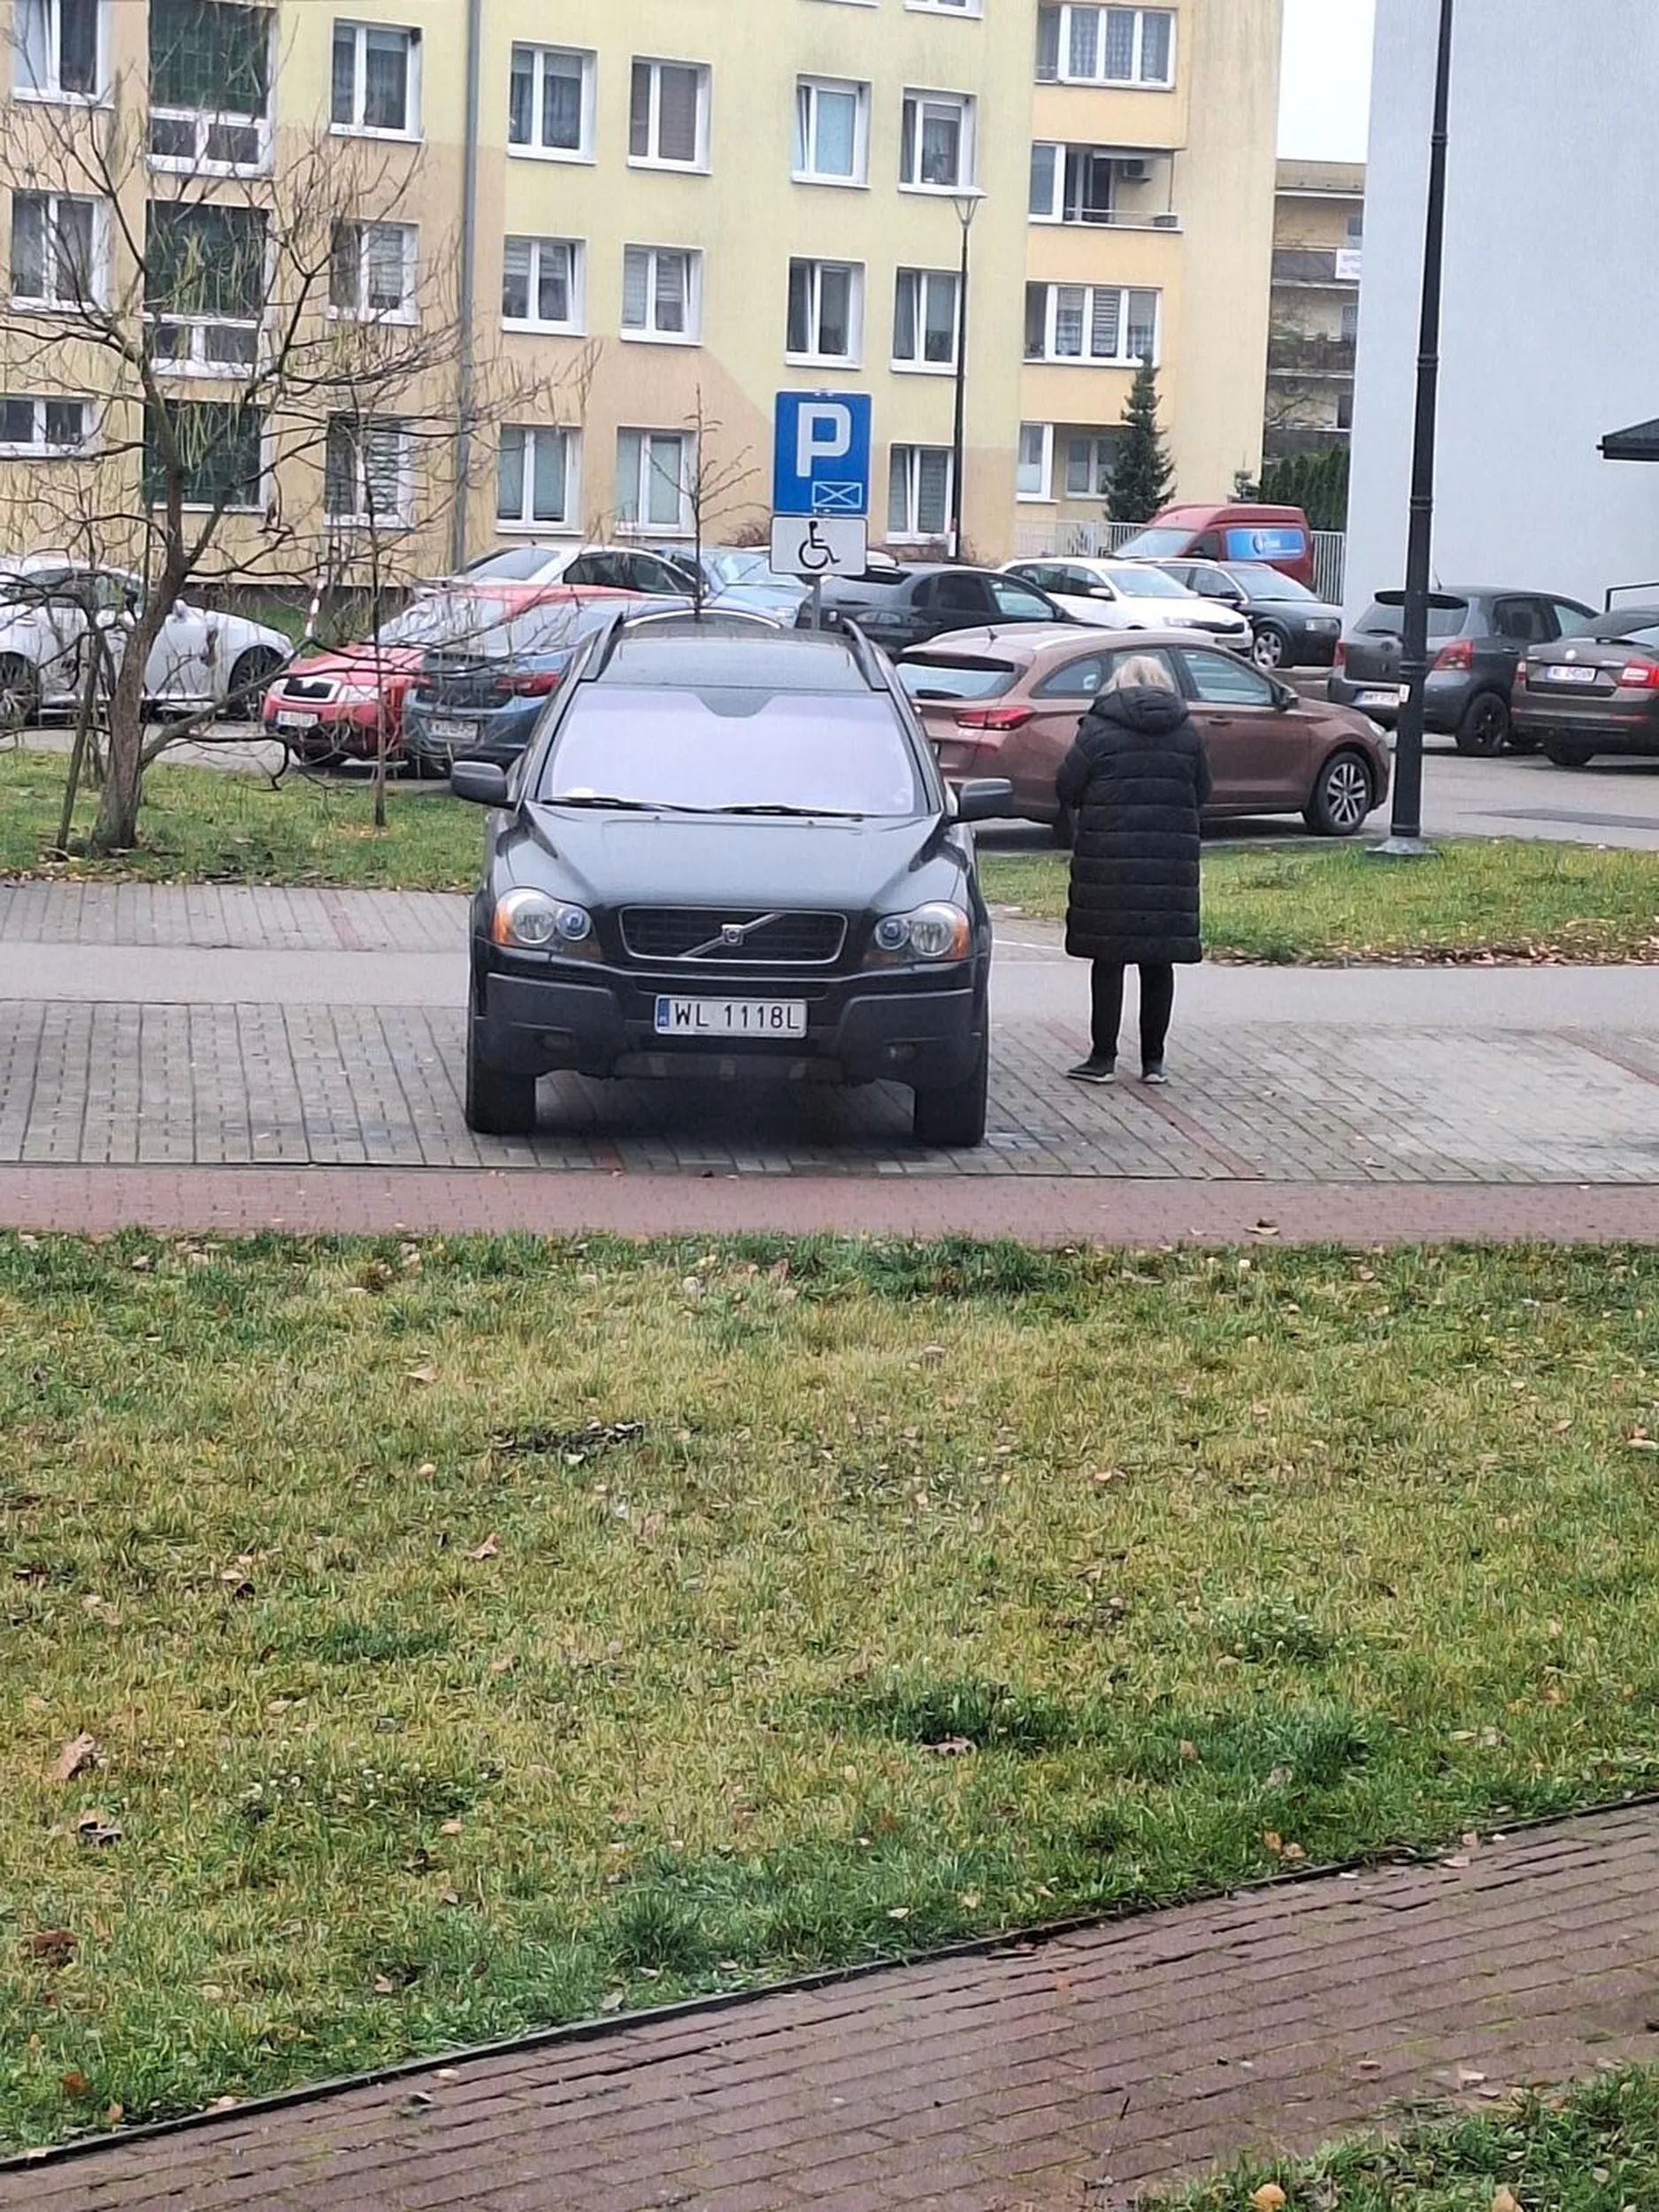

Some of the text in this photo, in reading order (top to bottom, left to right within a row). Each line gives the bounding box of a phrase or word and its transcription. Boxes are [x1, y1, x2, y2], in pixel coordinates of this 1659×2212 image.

[796, 403, 850, 477] P
[675, 1003, 800, 1029] WL 1118L
